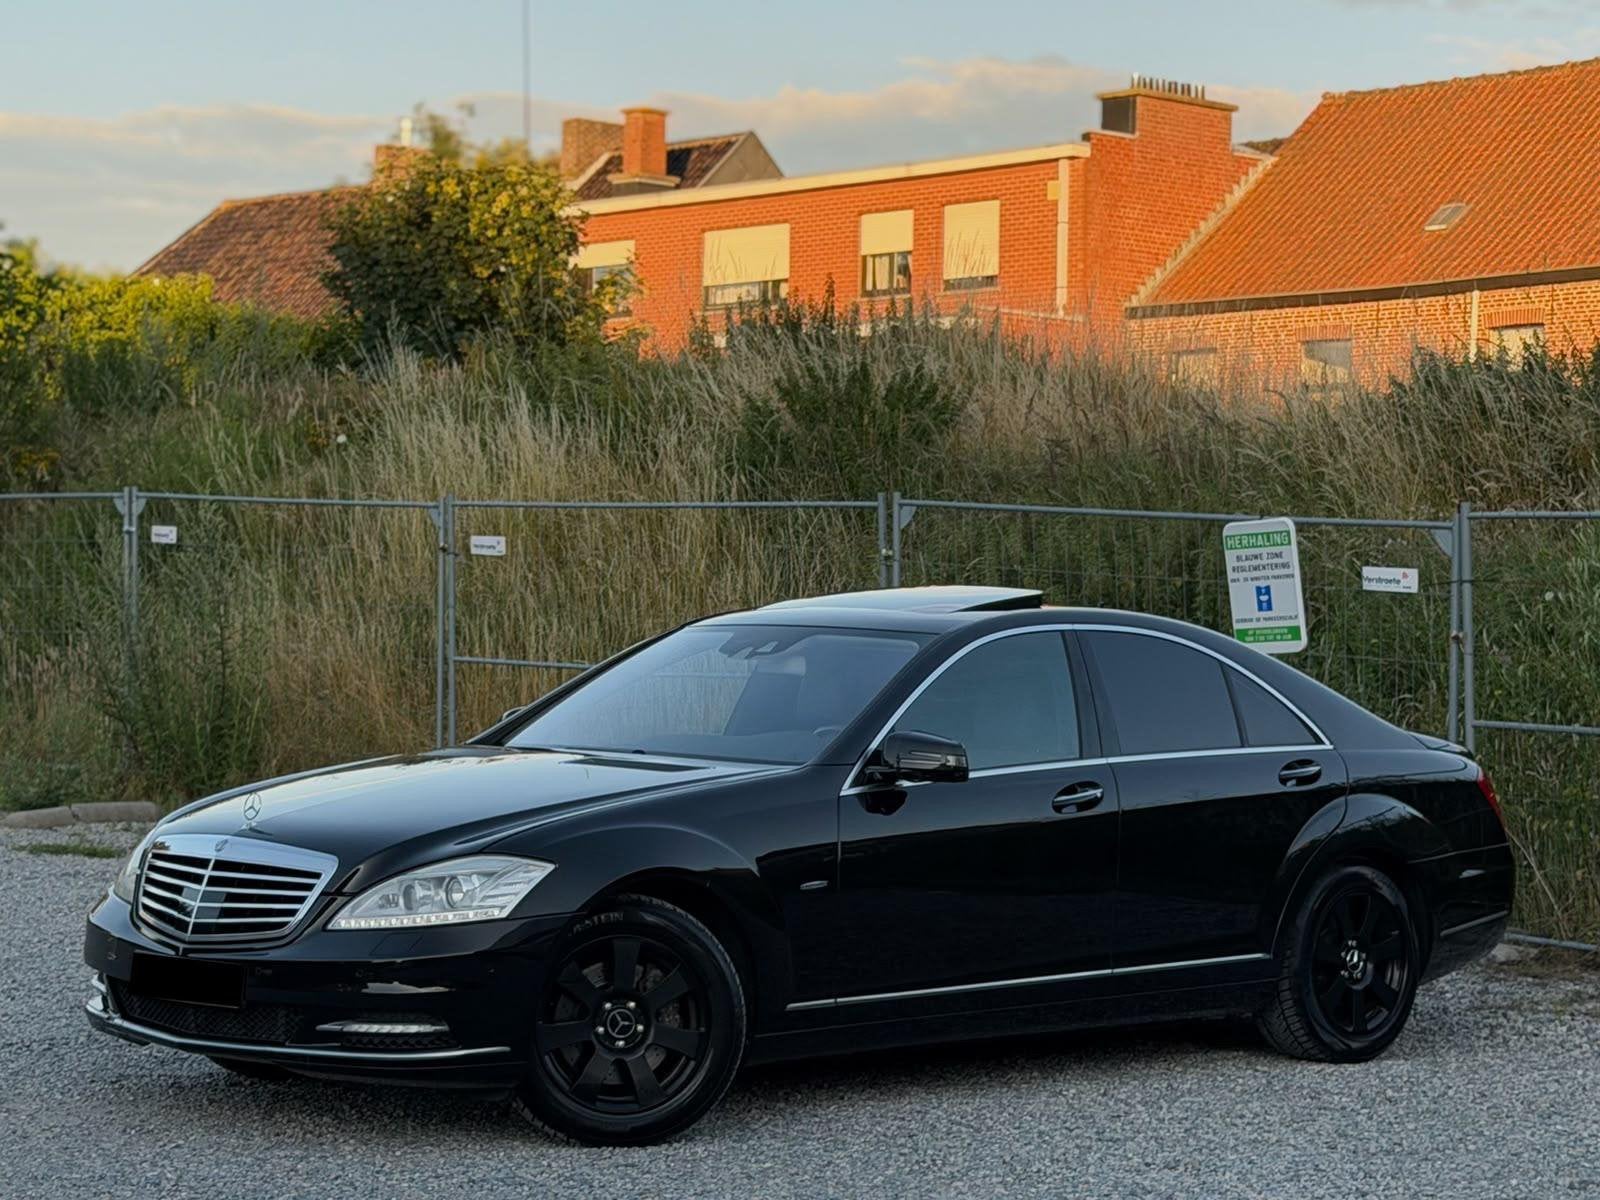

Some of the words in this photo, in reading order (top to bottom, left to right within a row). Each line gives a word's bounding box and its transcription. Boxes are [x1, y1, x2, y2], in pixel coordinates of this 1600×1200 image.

[1226, 532, 1289, 549] HERHALING
[1236, 552, 1263, 562] BLAUWE
[1266, 551, 1284, 560] ZONE
[1232, 561, 1291, 573] REGLEMENTERING
[1363, 575, 1401, 585] Verstraete
